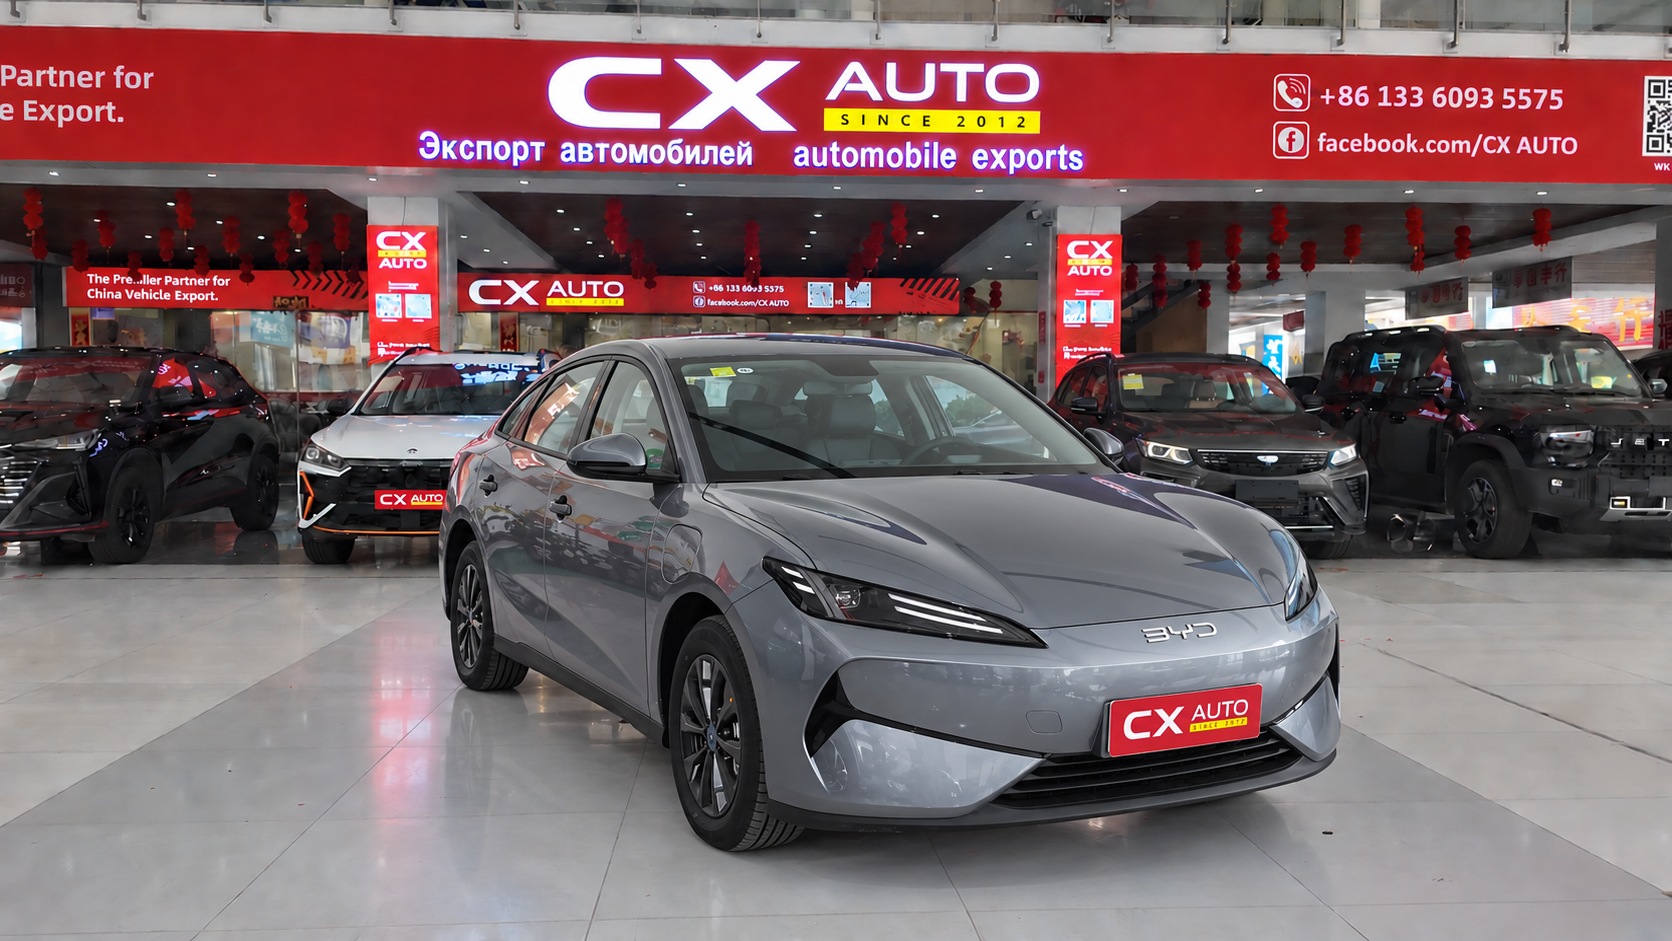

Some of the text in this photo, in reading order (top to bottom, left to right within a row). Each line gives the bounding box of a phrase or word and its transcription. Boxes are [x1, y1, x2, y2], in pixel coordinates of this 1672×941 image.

[0, 64, 154, 89] Partner for
[548, 56, 1040, 132] CX AUTO
[1319, 84, 1564, 110] +86 133 6093 5575
[23, 100, 124, 128] Export.
[840, 113, 1026, 128] SINCE 2012
[418, 130, 753, 167] Экспорт автомобилей
[1317, 132, 1579, 157] facebook.com/CX AUTO
[793, 141, 1084, 175] automobile exports
[1653, 162, 1671, 171] WK
[376, 230, 427, 251] CX
[1066, 240, 1114, 259] CX
[378, 257, 428, 269] AUTO
[1067, 265, 1113, 276] AUTO
[87, 273, 110, 285] The
[164, 275, 210, 287] Partner
[212, 275, 231, 287] for
[726, 284, 740, 293] 133
[86, 288, 219, 304] China Vehicle Export.
[468, 279, 625, 306] CX AUTO
[769, 299, 790, 307] AUTO
[380, 494, 443, 506] CX AUTO
[1141, 622, 1218, 643] BYD
[1123, 699, 1249, 740] CX AUTO
